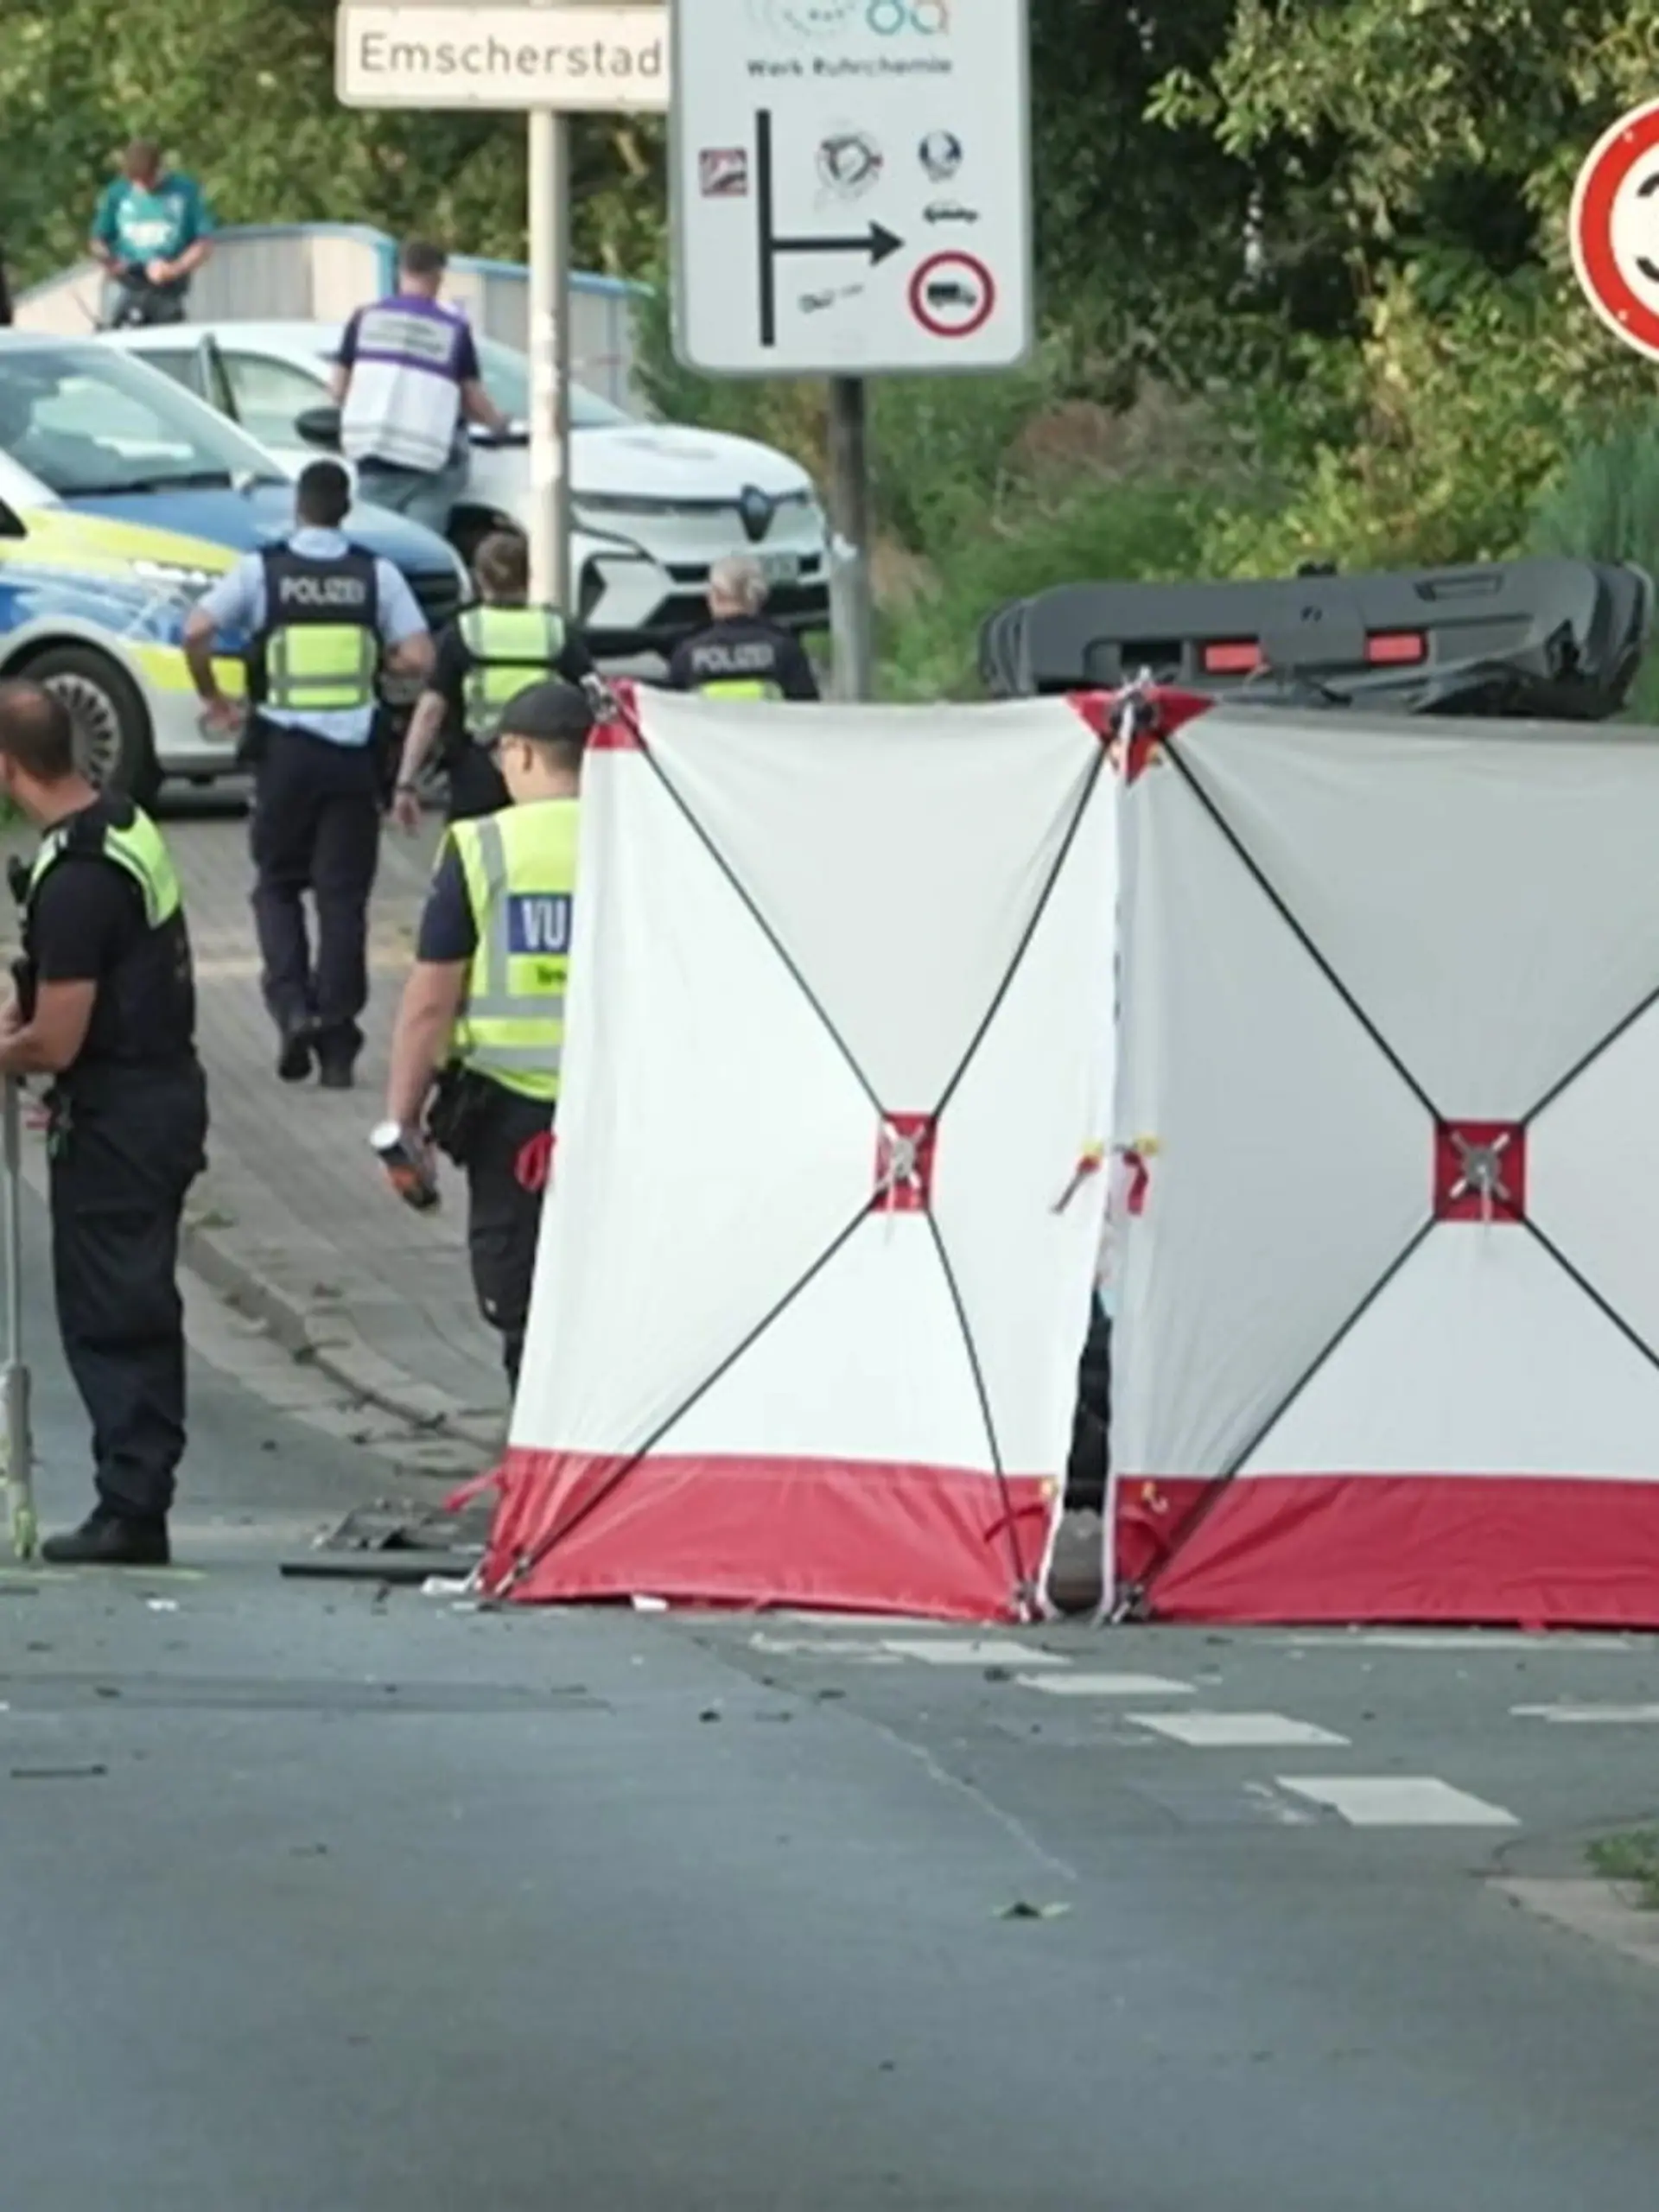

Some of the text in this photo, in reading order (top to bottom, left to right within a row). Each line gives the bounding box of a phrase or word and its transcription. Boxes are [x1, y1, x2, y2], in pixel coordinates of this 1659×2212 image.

[359, 34, 661, 77] Emscherstad
[279, 576, 366, 605] POLIZEI
[692, 643, 775, 673] POLIZEI
[522, 899, 567, 950] VU
